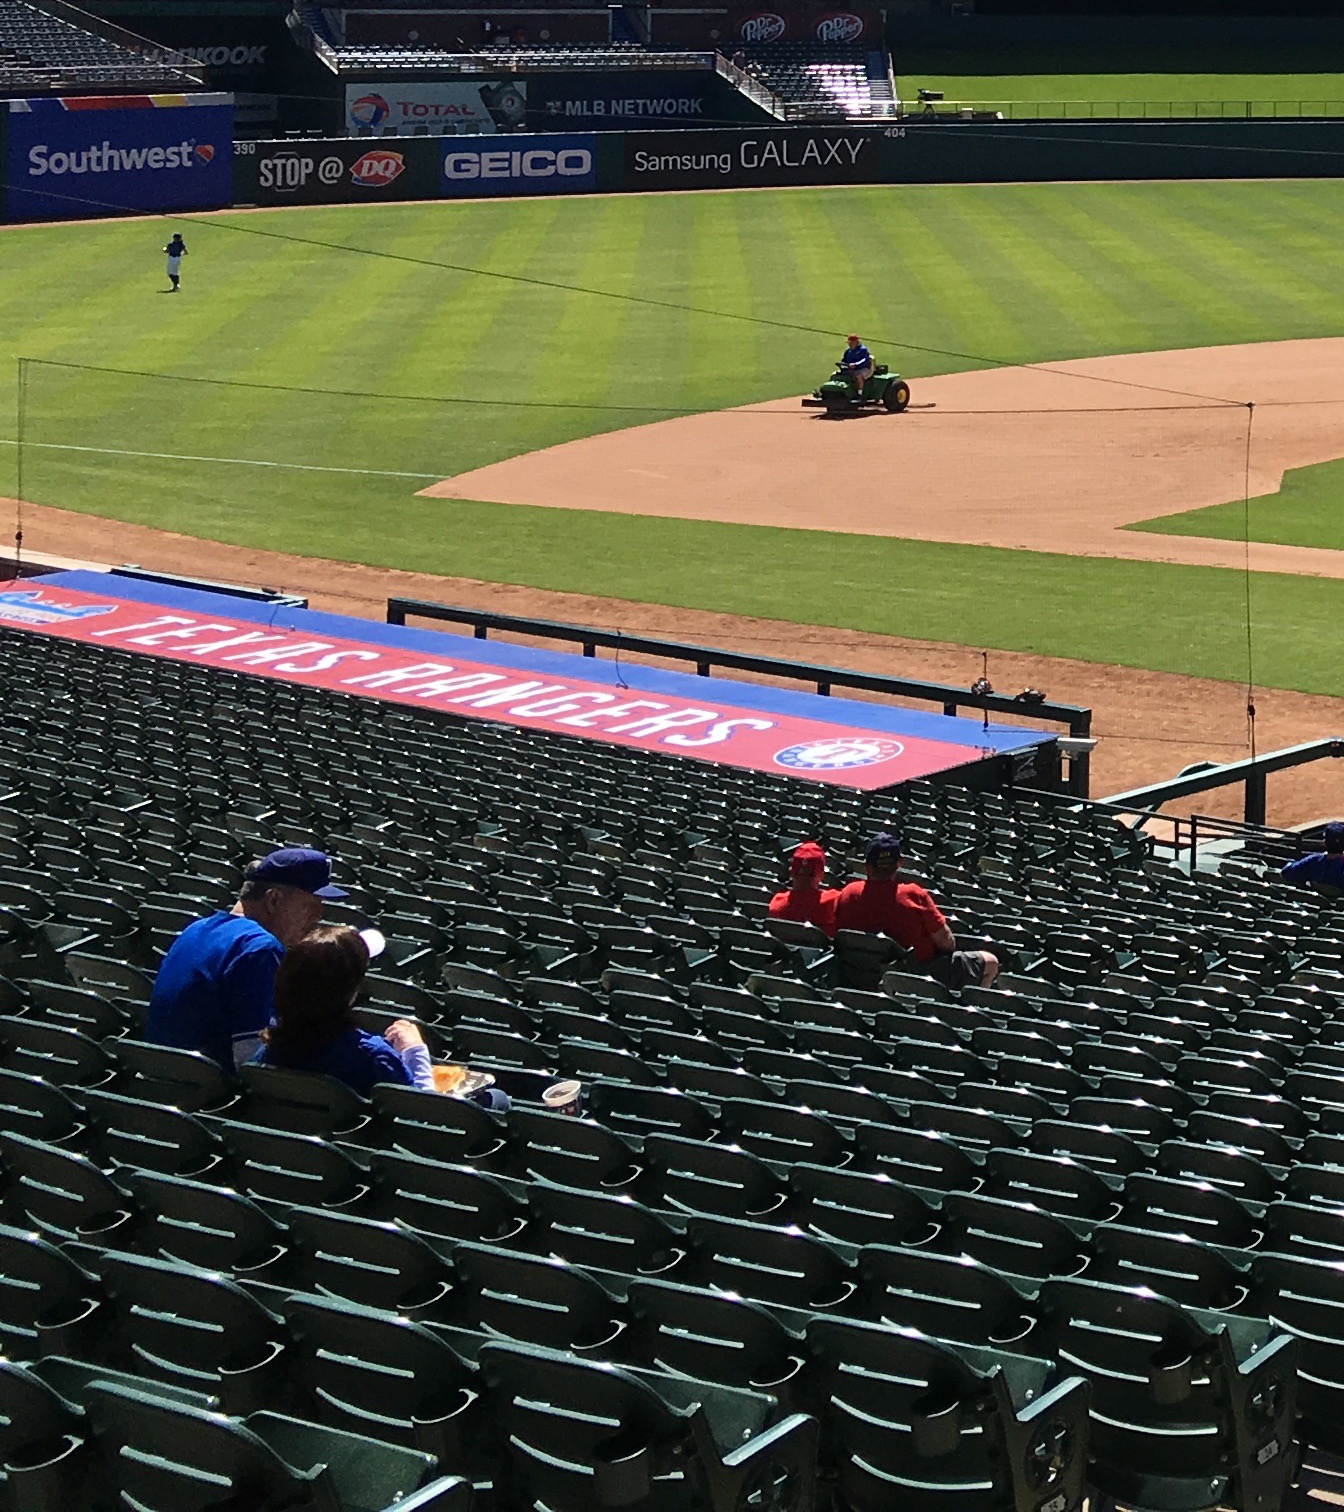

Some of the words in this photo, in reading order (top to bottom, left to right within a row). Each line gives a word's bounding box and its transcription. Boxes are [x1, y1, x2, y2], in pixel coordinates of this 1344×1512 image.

[742, 20, 781, 42] Pepper
[757, 17, 772, 30] Dr
[817, 20, 860, 42] Pepper
[834, 17, 850, 30] Dr
[397, 101, 476, 117] TOTAL
[565, 99, 606, 116] MLB
[610, 98, 703, 115] NETWORK
[883, 127, 906, 138] 404
[28, 140, 194, 176] Southwest
[233, 143, 256, 156] 390
[740, 138, 865, 169] GALAXY
[259, 157, 314, 187] STOP
[318, 156, 344, 185] @
[360, 158, 398, 178] DQ
[444, 148, 592, 180] GEICO
[634, 150, 732, 174] Samsung
[91, 614, 382, 674] TEXAS
[380, 662, 774, 748] RANGERS
